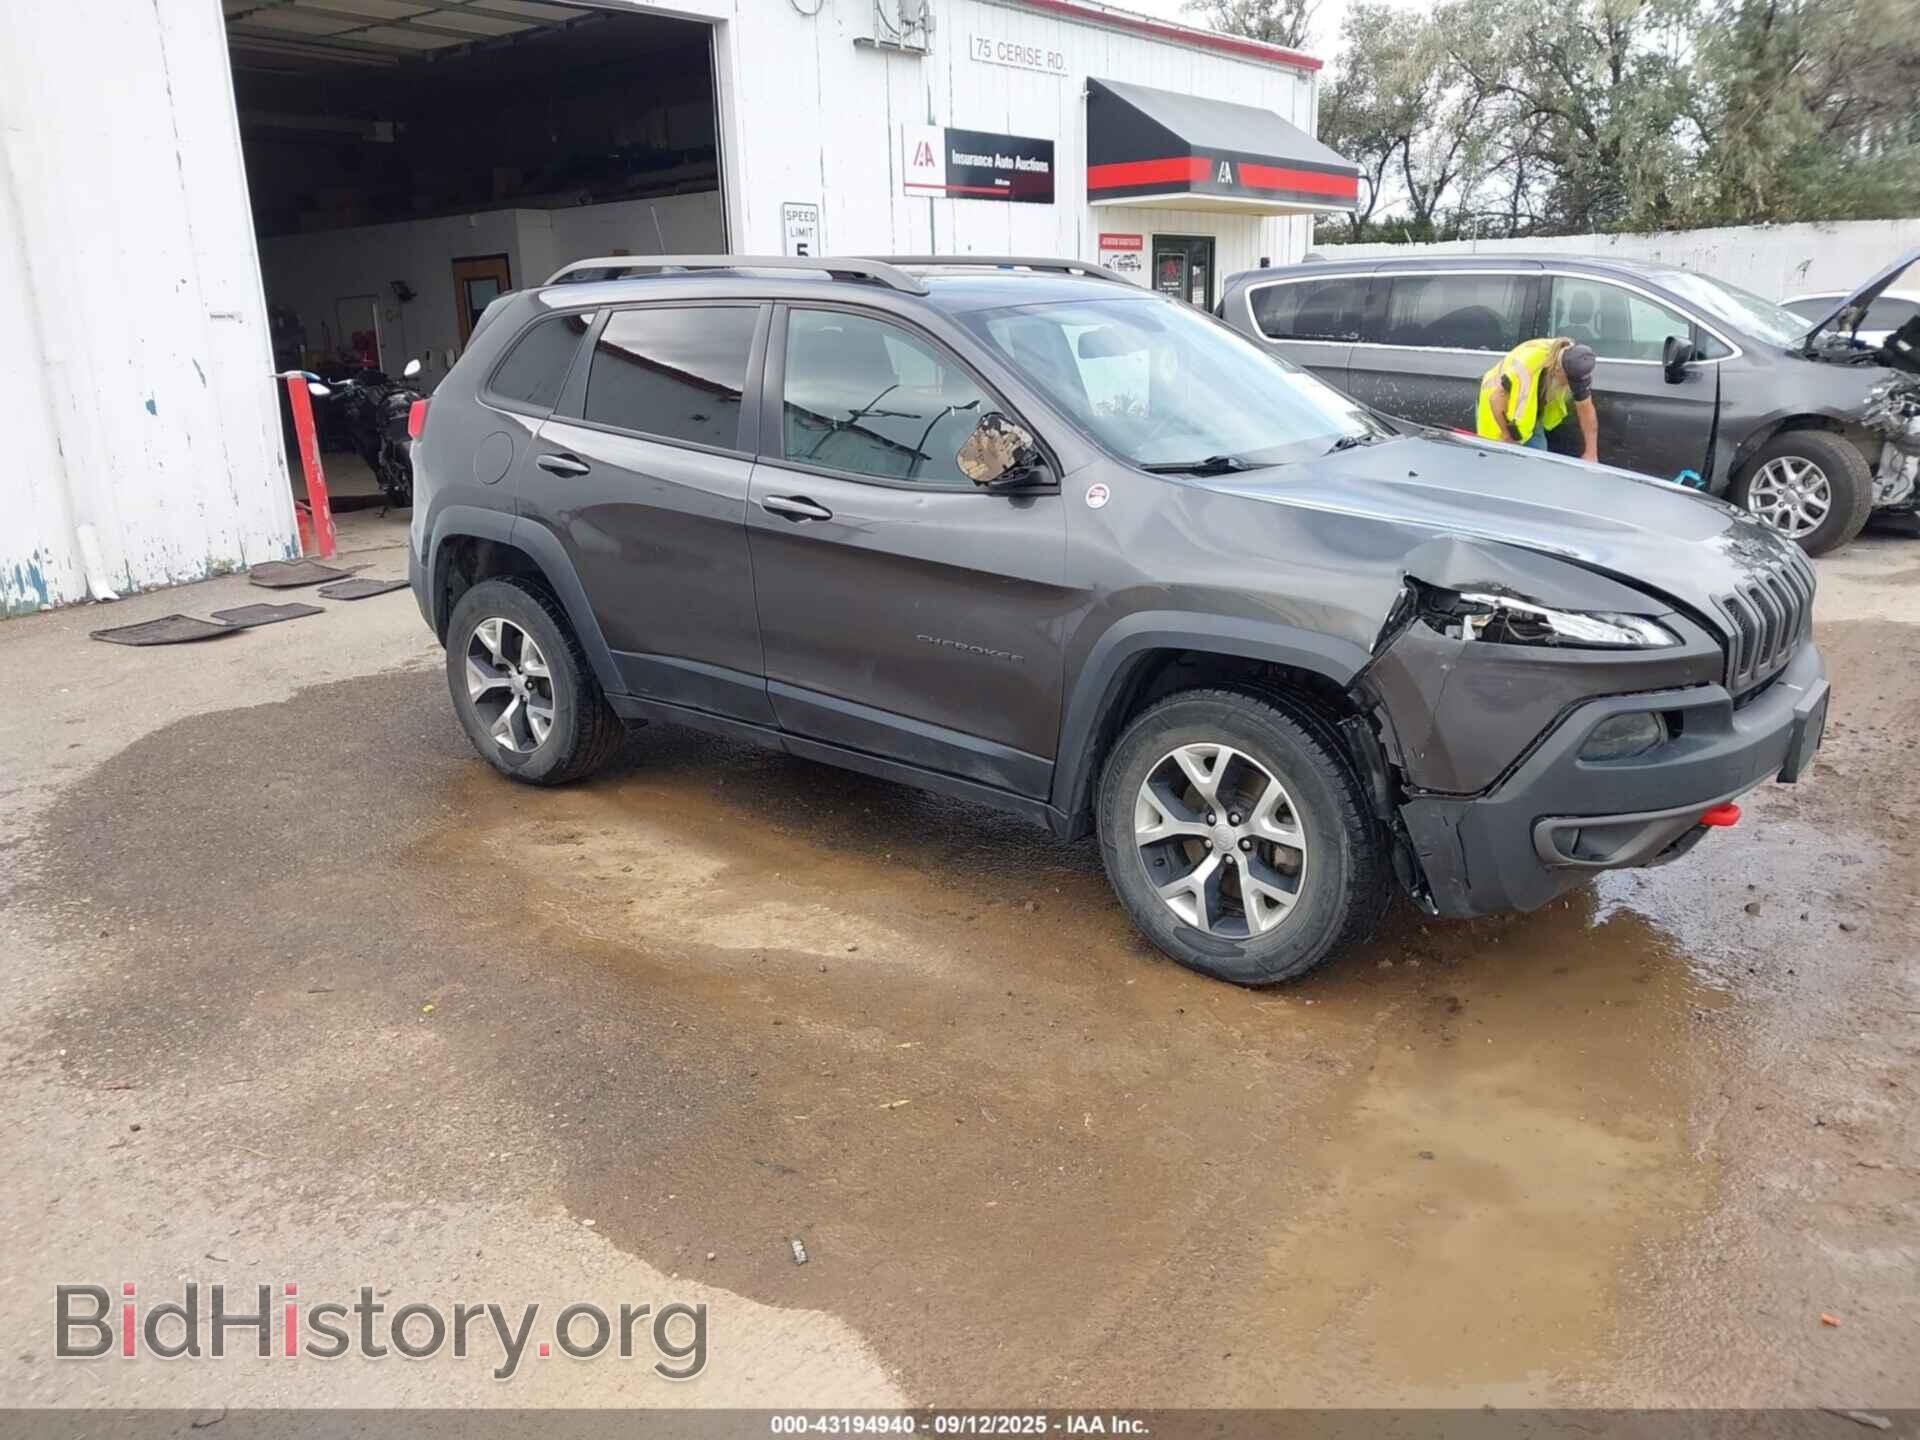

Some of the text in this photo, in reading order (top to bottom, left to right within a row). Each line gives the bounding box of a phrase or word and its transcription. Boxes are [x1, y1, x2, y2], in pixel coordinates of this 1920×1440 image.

[976, 37, 991, 58] 75
[997, 41, 1042, 67] CERISE
[951, 149, 1049, 173] Insurance Auto Auctions
[786, 210, 816, 222] SPEED
[790, 226, 813, 239] LIMIT
